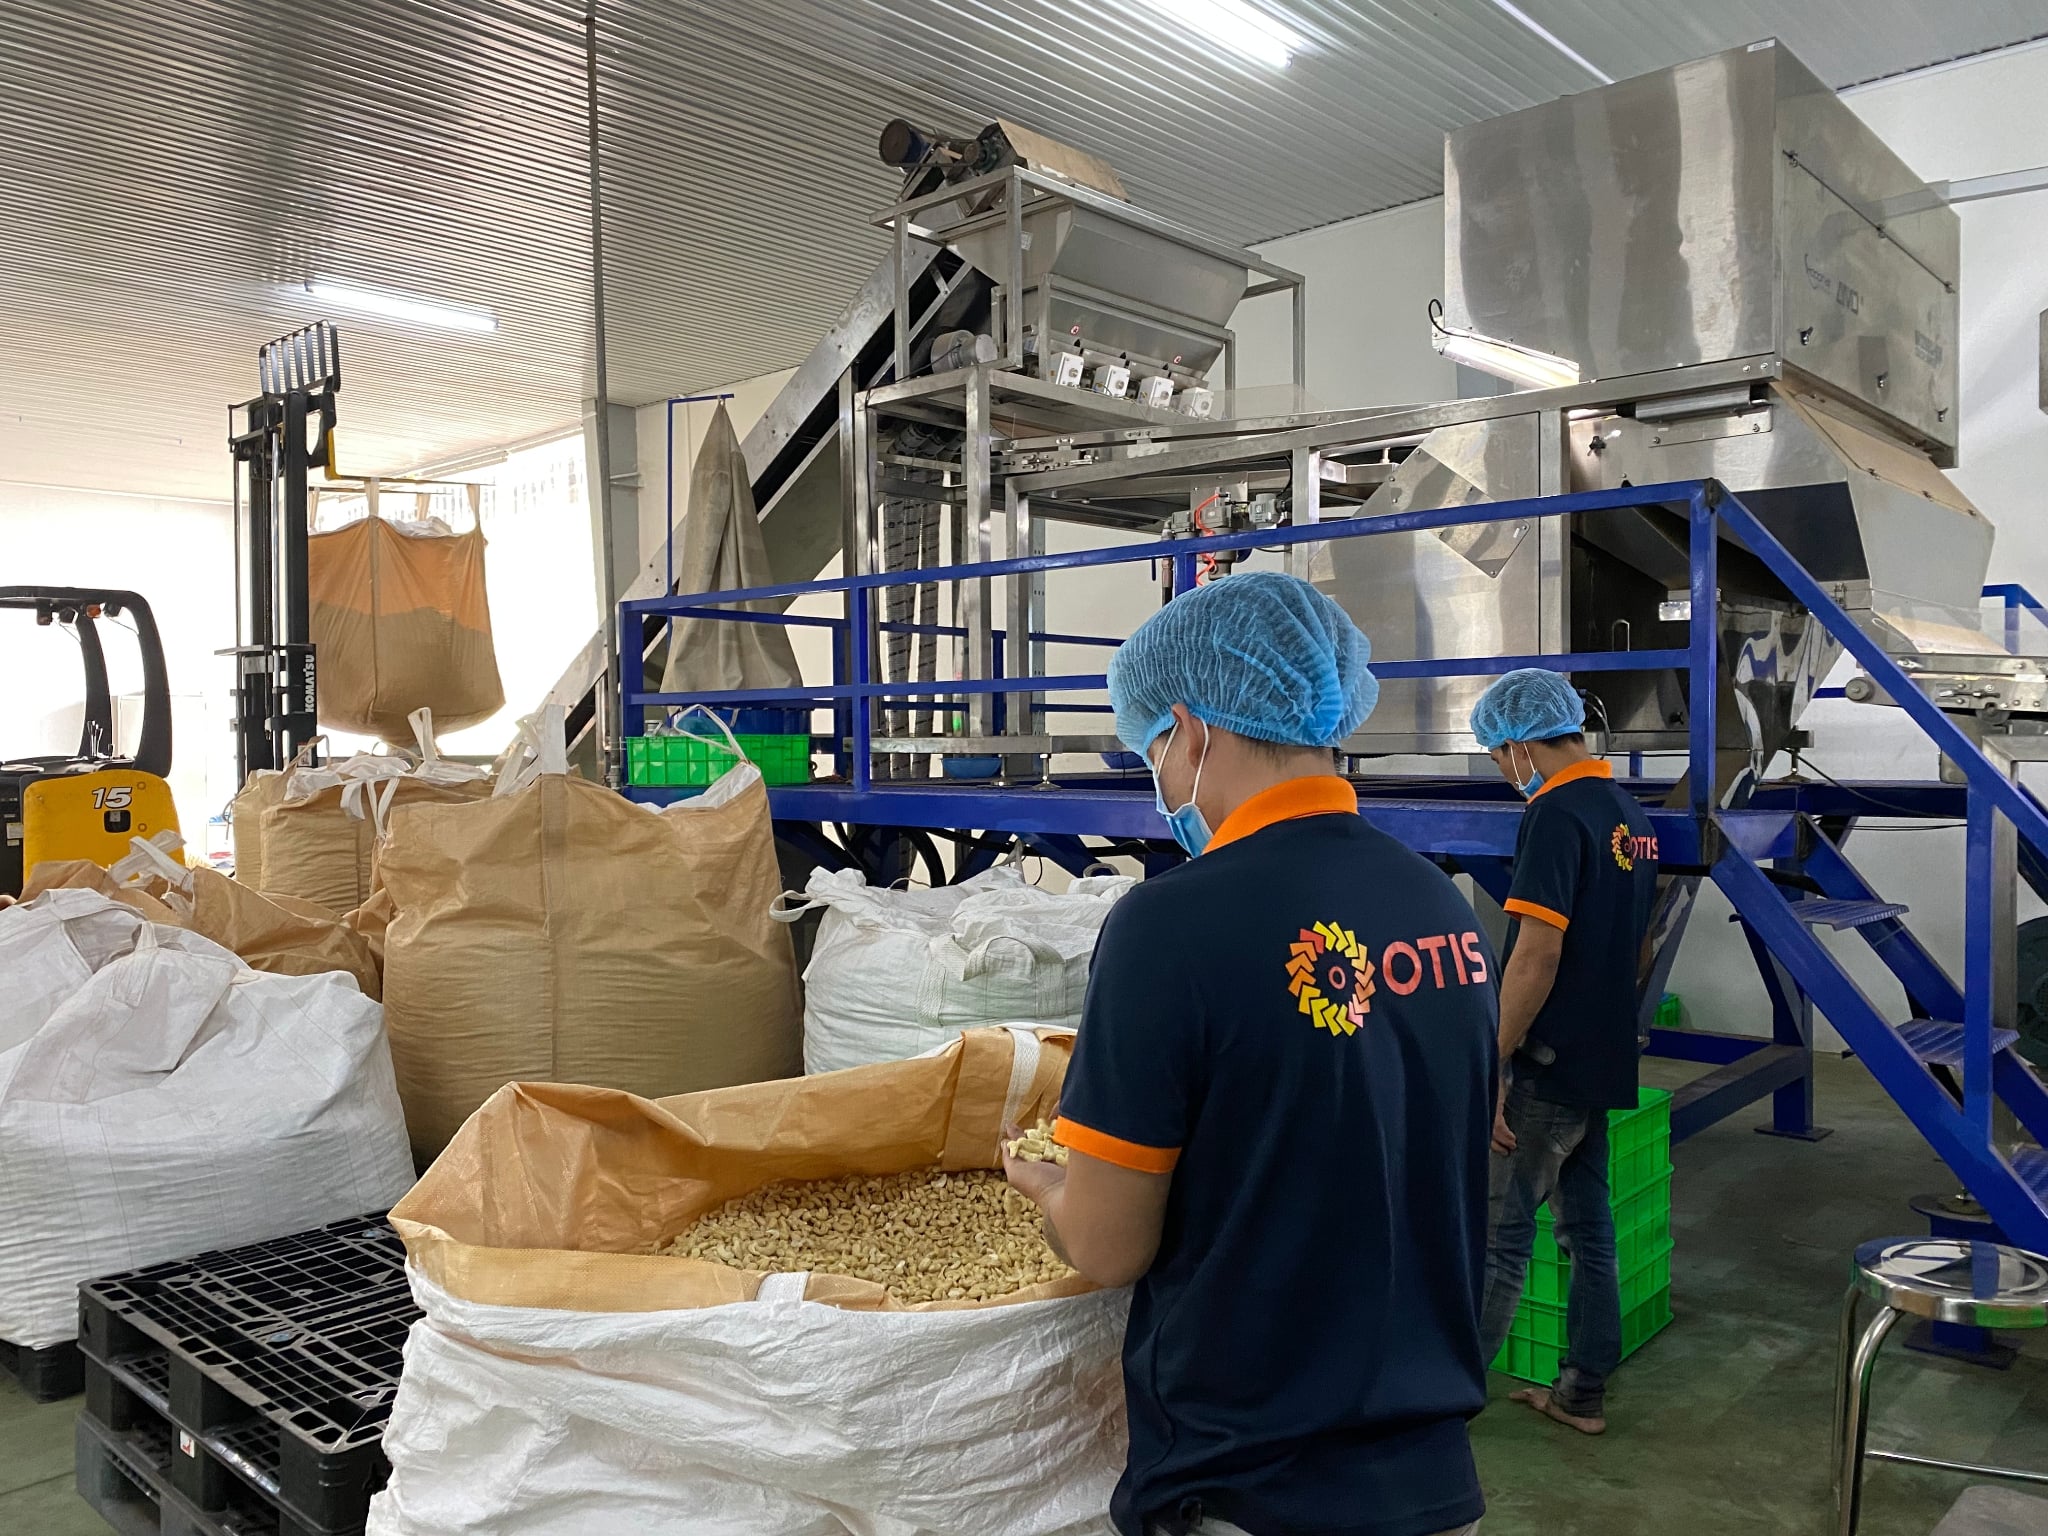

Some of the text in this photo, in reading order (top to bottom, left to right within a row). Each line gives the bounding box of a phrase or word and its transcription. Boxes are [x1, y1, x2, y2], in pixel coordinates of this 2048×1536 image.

[303, 655, 315, 713] KOMATSU
[92, 786, 133, 809] 15
[1630, 836, 1659, 860] OTIS
[1382, 931, 1488, 996] OTIS
